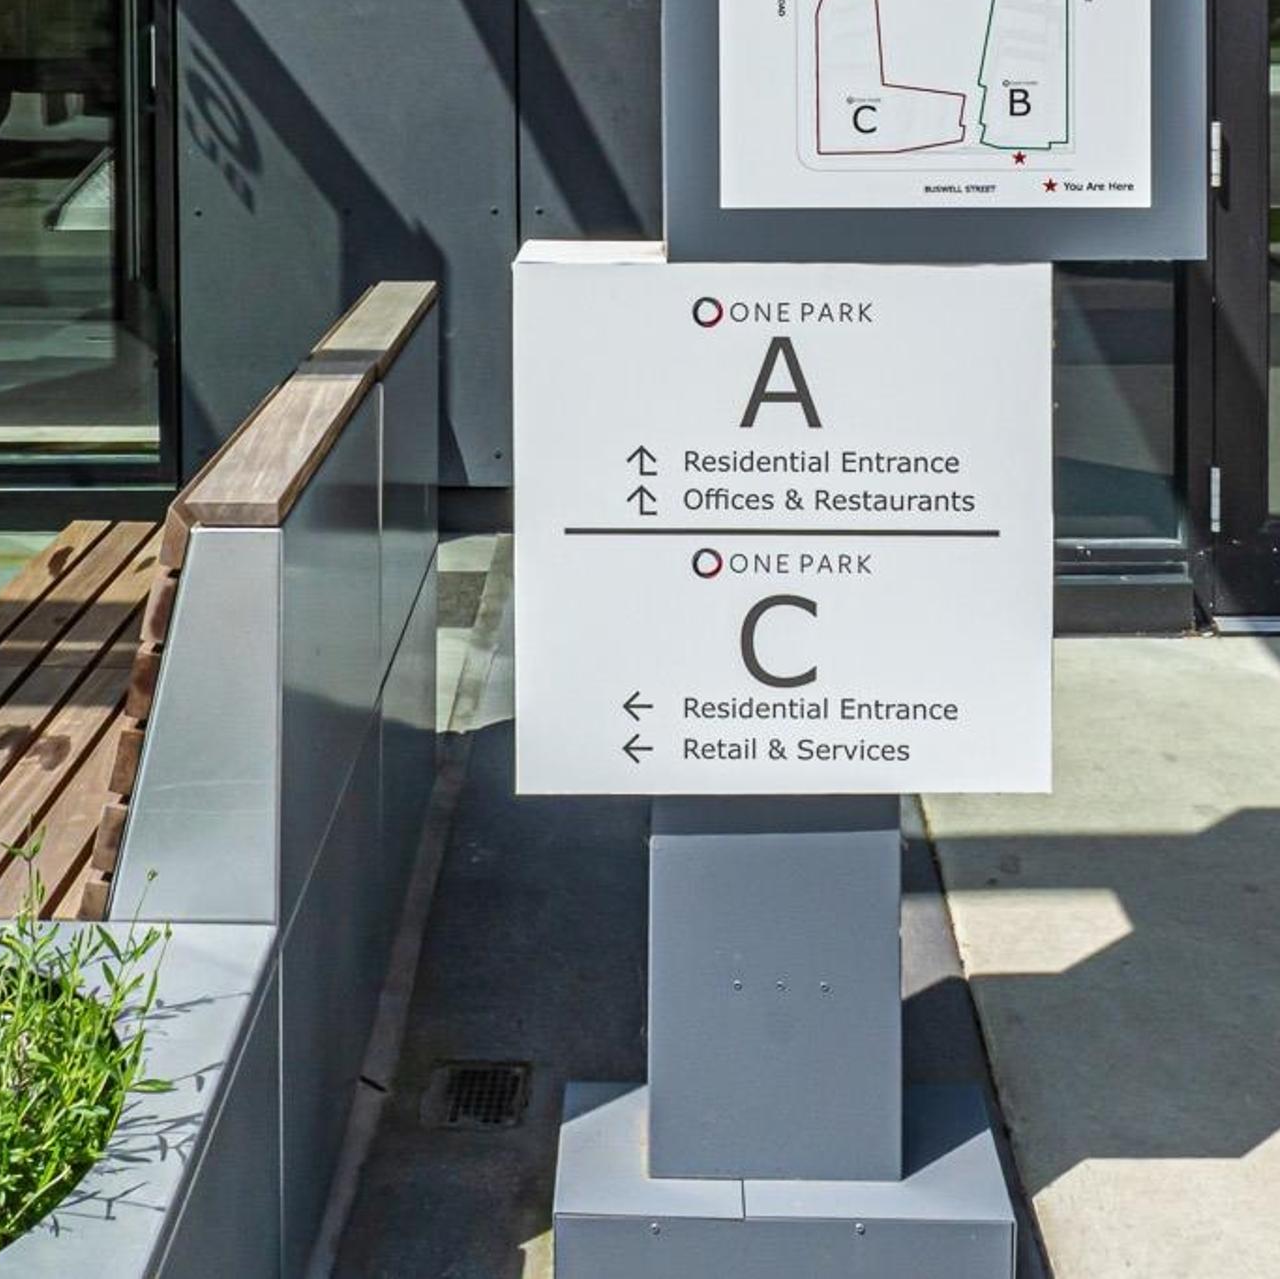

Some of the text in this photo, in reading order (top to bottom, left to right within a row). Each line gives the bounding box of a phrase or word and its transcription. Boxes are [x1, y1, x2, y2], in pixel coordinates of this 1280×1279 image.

[1010, 89, 1031, 116] B
[853, 105, 876, 134] C
[1063, 181, 1134, 192] You Are Here
[730, 302, 872, 322] ONE PARK
[740, 336, 822, 428] A
[685, 450, 959, 473] Residential Entrance
[684, 488, 975, 512] Offices & Restaurants
[730, 554, 871, 574] ONE PARK
[741, 594, 817, 688] C
[685, 697, 958, 720] Residential Entrance
[684, 738, 909, 761] Retail & Services
